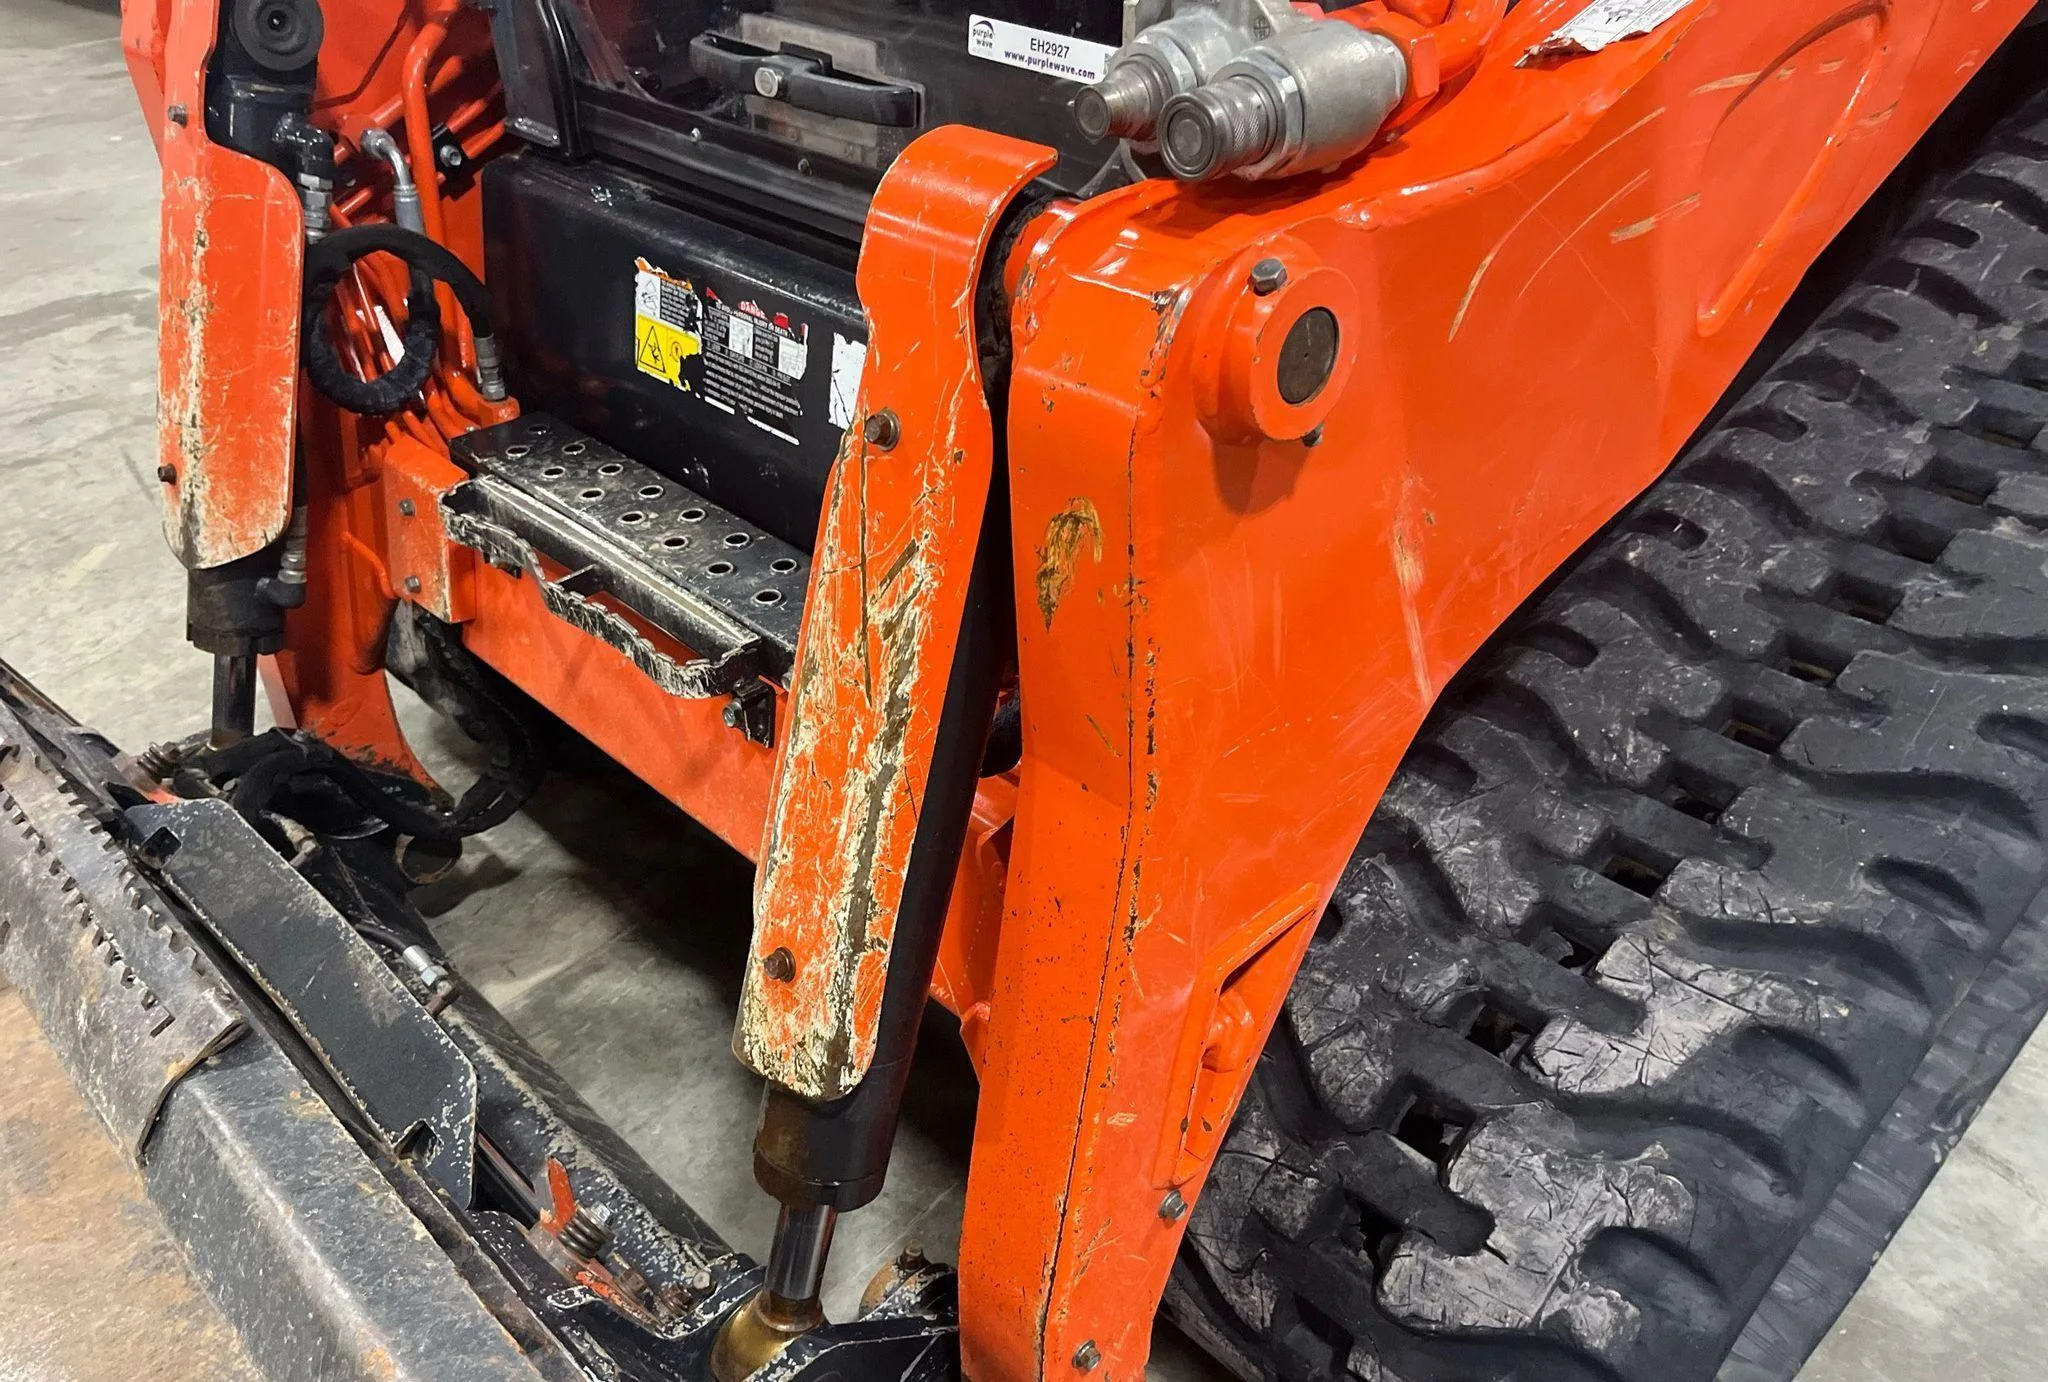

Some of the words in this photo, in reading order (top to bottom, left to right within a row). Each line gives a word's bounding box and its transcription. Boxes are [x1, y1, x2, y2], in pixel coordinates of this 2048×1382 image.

[972, 28, 993, 39] purple
[976, 39, 993, 49] wave
[1030, 38, 1070, 58] EH2927
[1004, 50, 1095, 79] www.purplewave.com
[740, 300, 767, 320] DANGE
